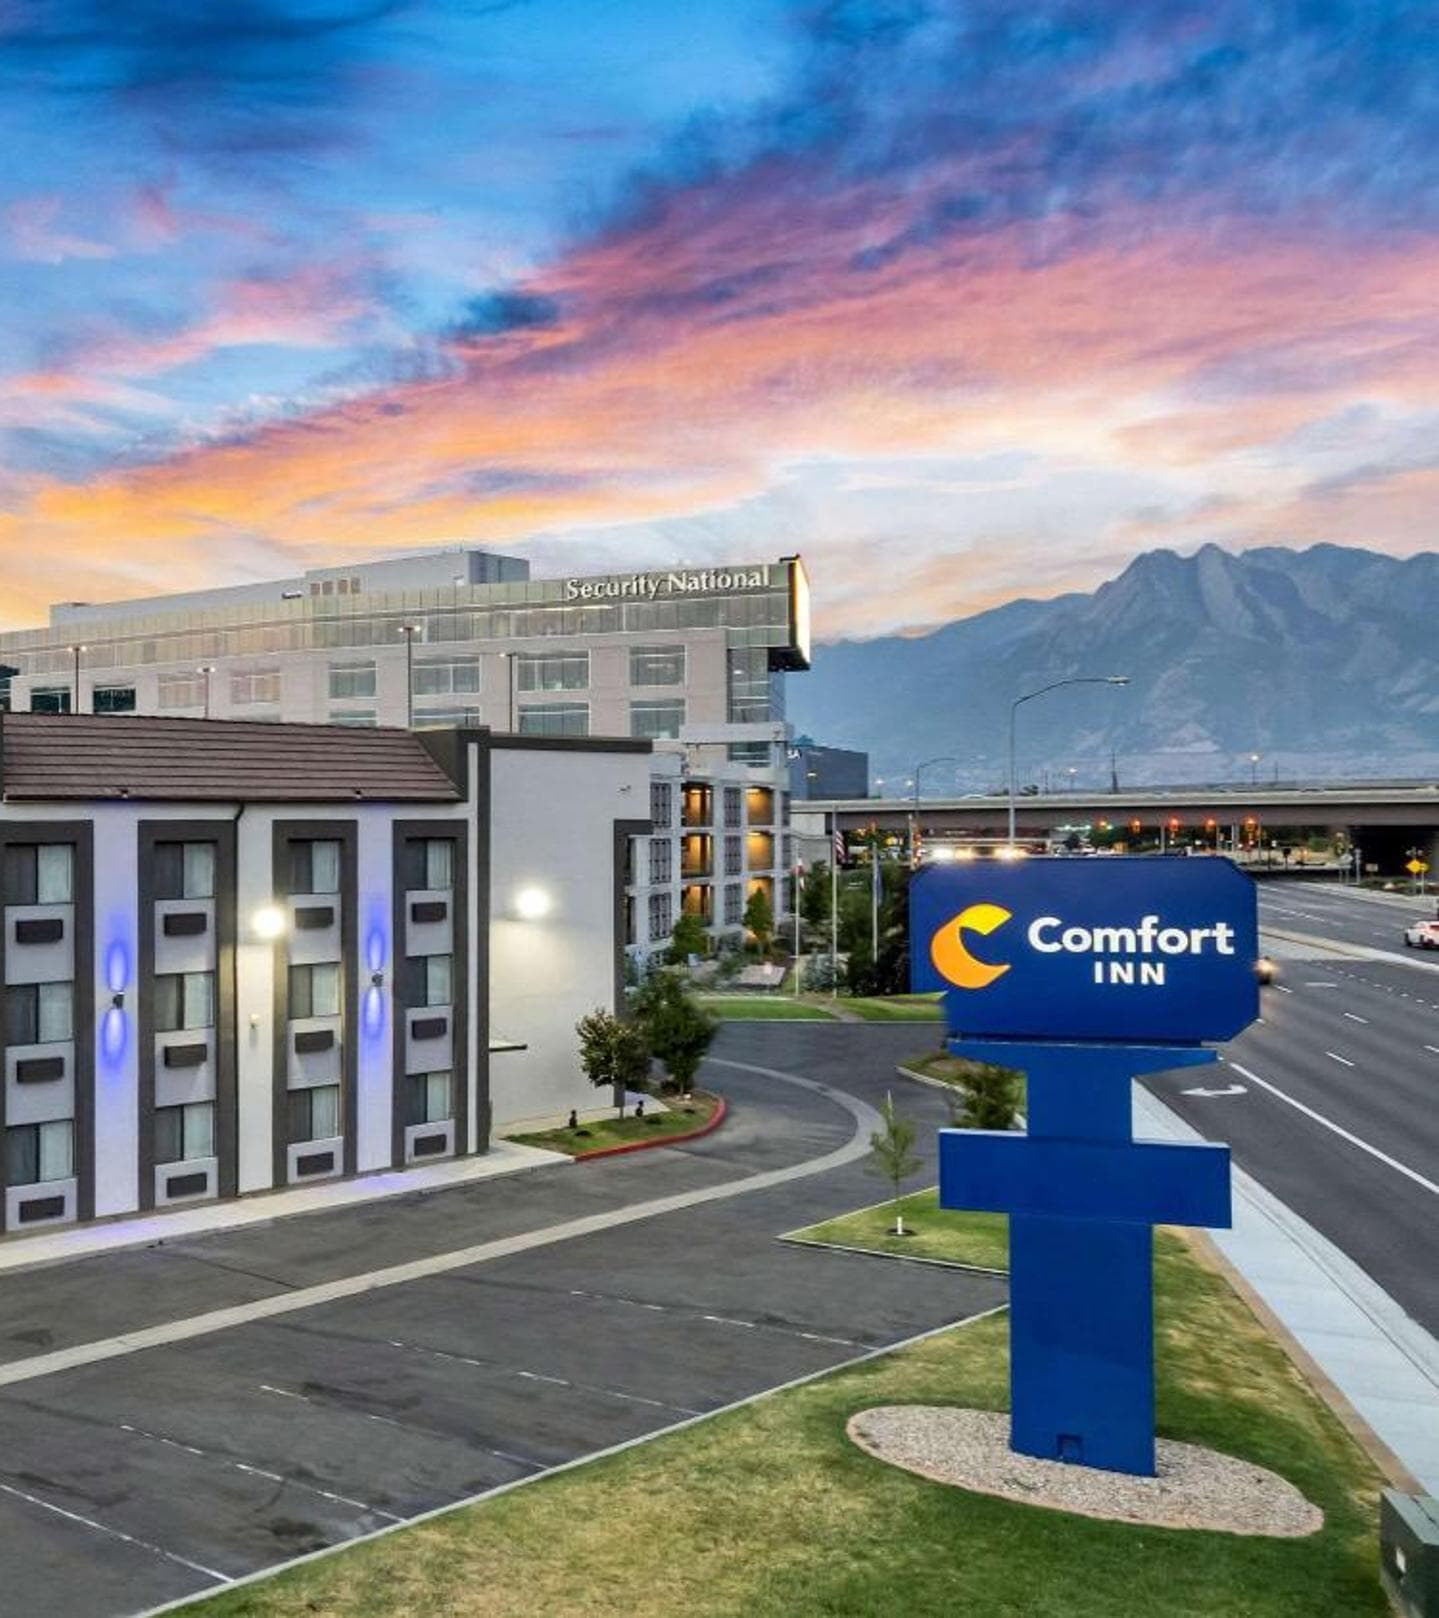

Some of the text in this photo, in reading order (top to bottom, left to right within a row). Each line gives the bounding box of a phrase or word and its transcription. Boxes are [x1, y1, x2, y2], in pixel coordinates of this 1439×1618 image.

[566, 564, 770, 600] Security National
[1027, 915, 1236, 955] Comfort
[1094, 961, 1166, 986] INN
